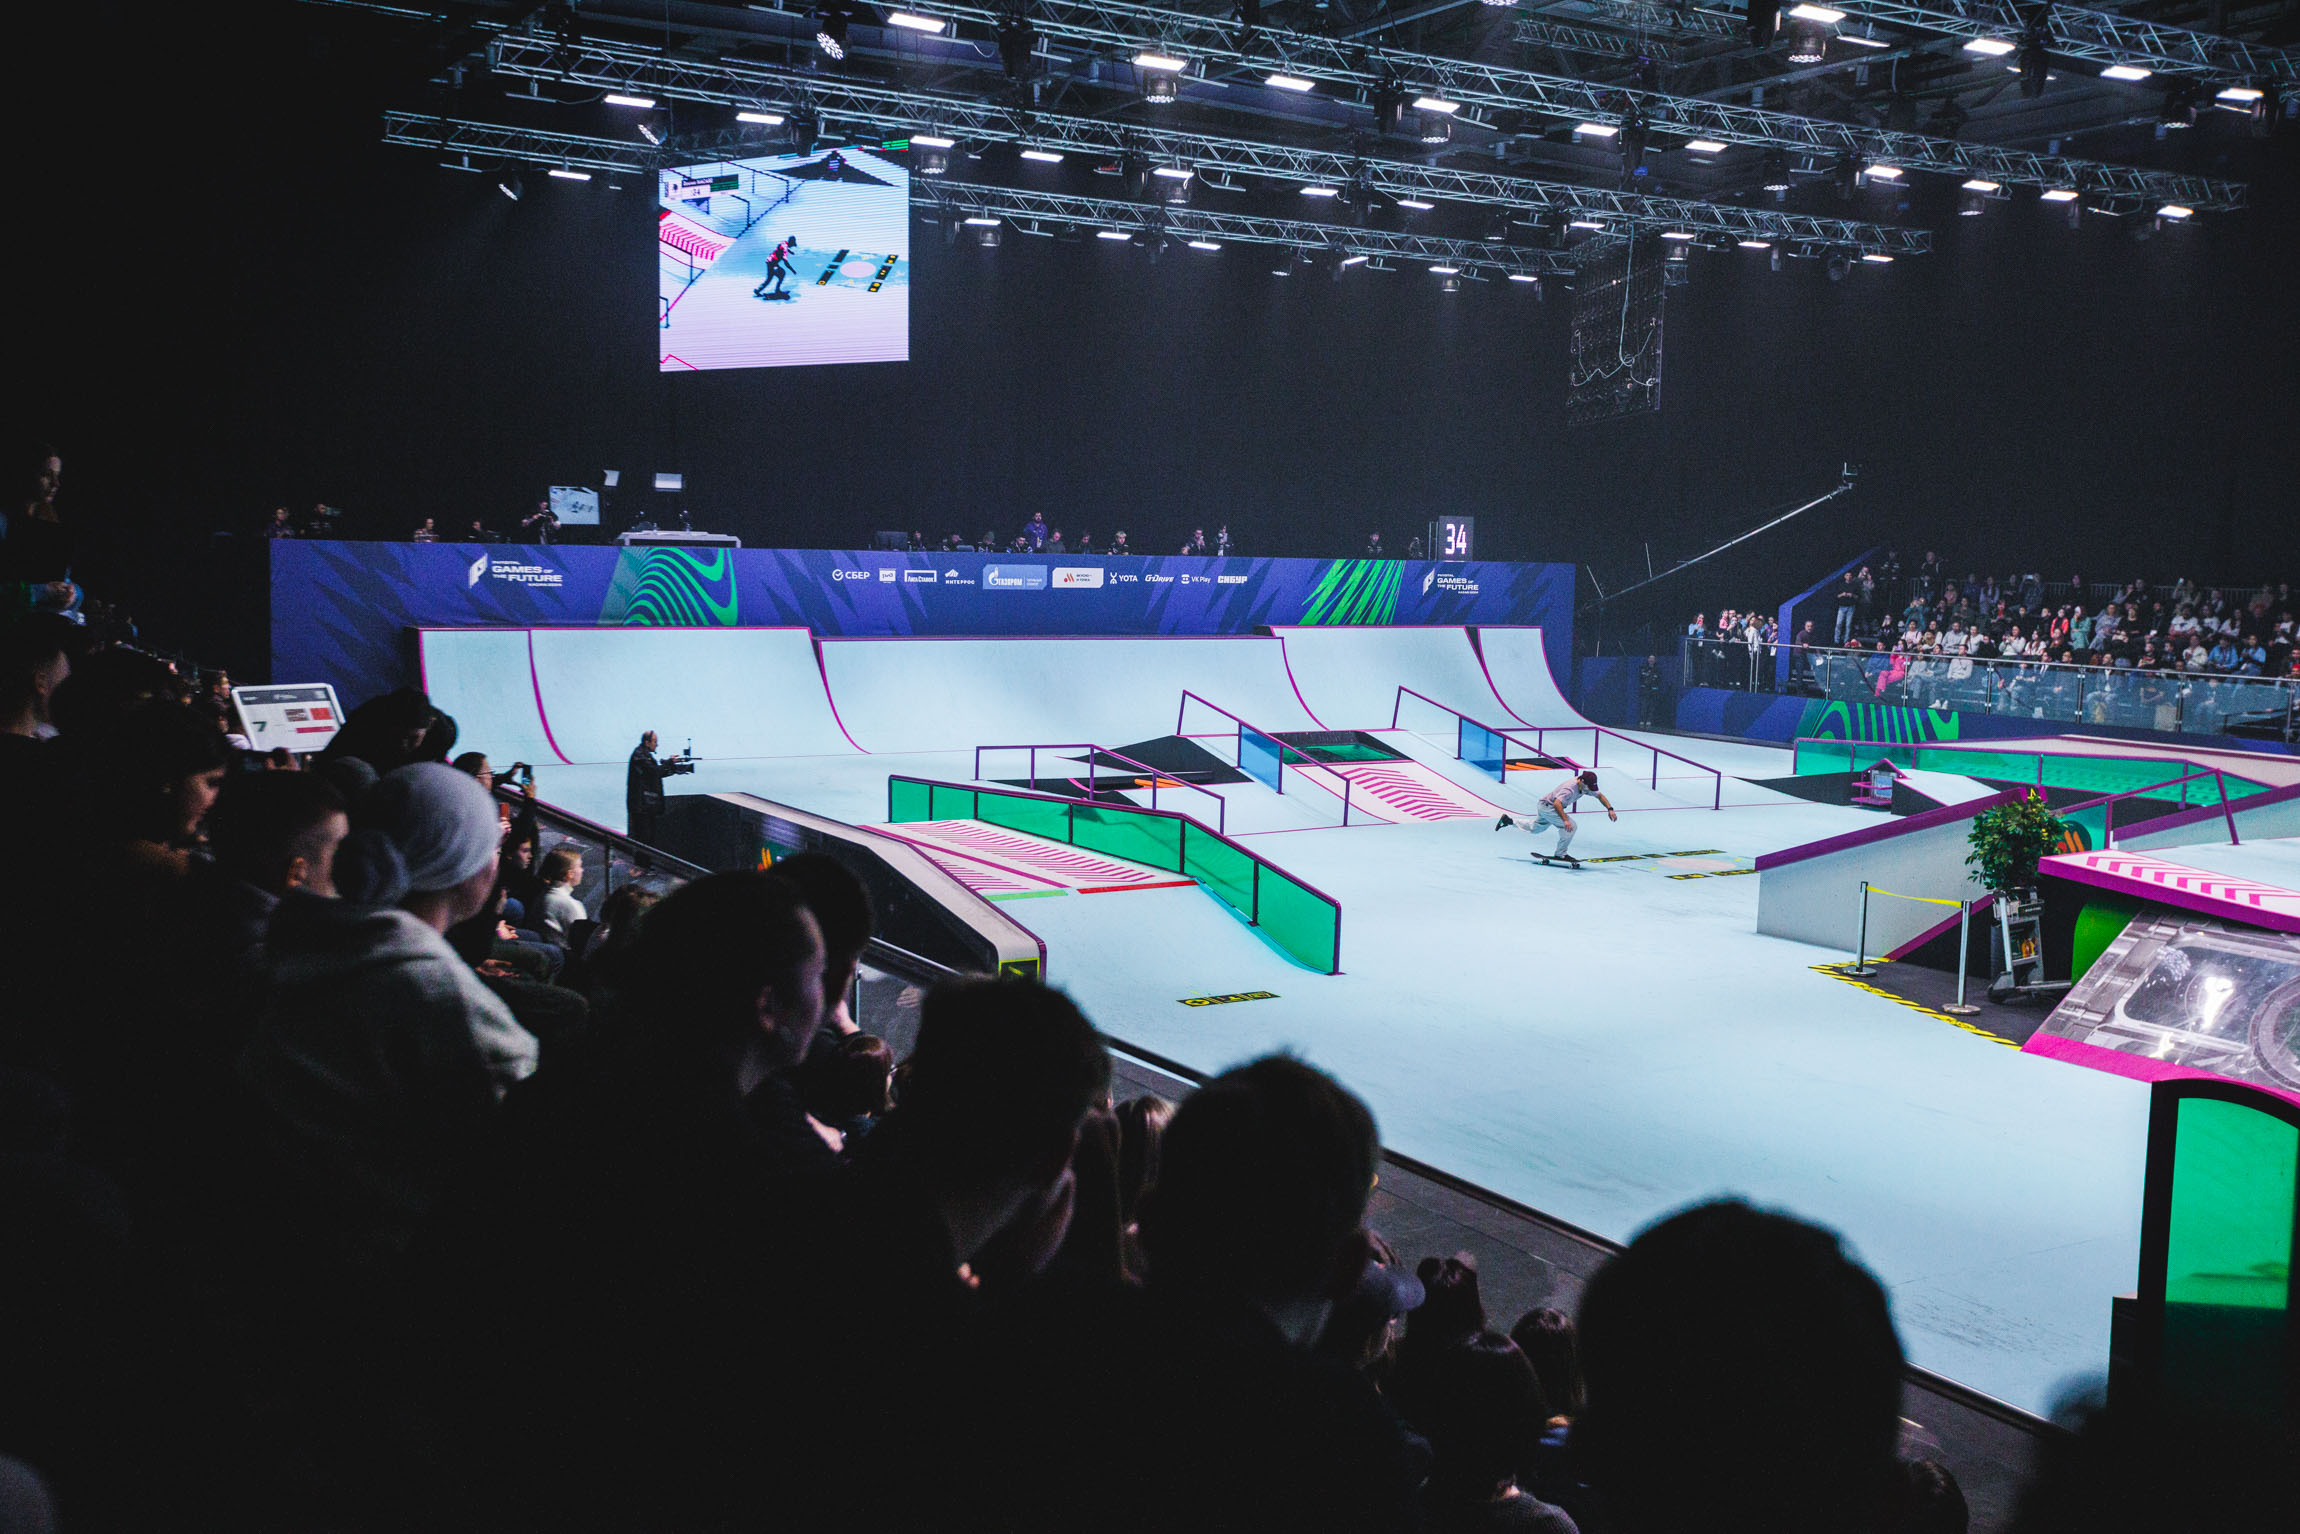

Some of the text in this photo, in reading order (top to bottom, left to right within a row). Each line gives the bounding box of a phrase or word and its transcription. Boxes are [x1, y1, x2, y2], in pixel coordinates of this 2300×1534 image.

[1445, 524, 1467, 555] 34
[845, 571, 870, 579] СБЕР
[1217, 575, 1248, 584] СИБУР
[252, 721, 267, 732] 7
